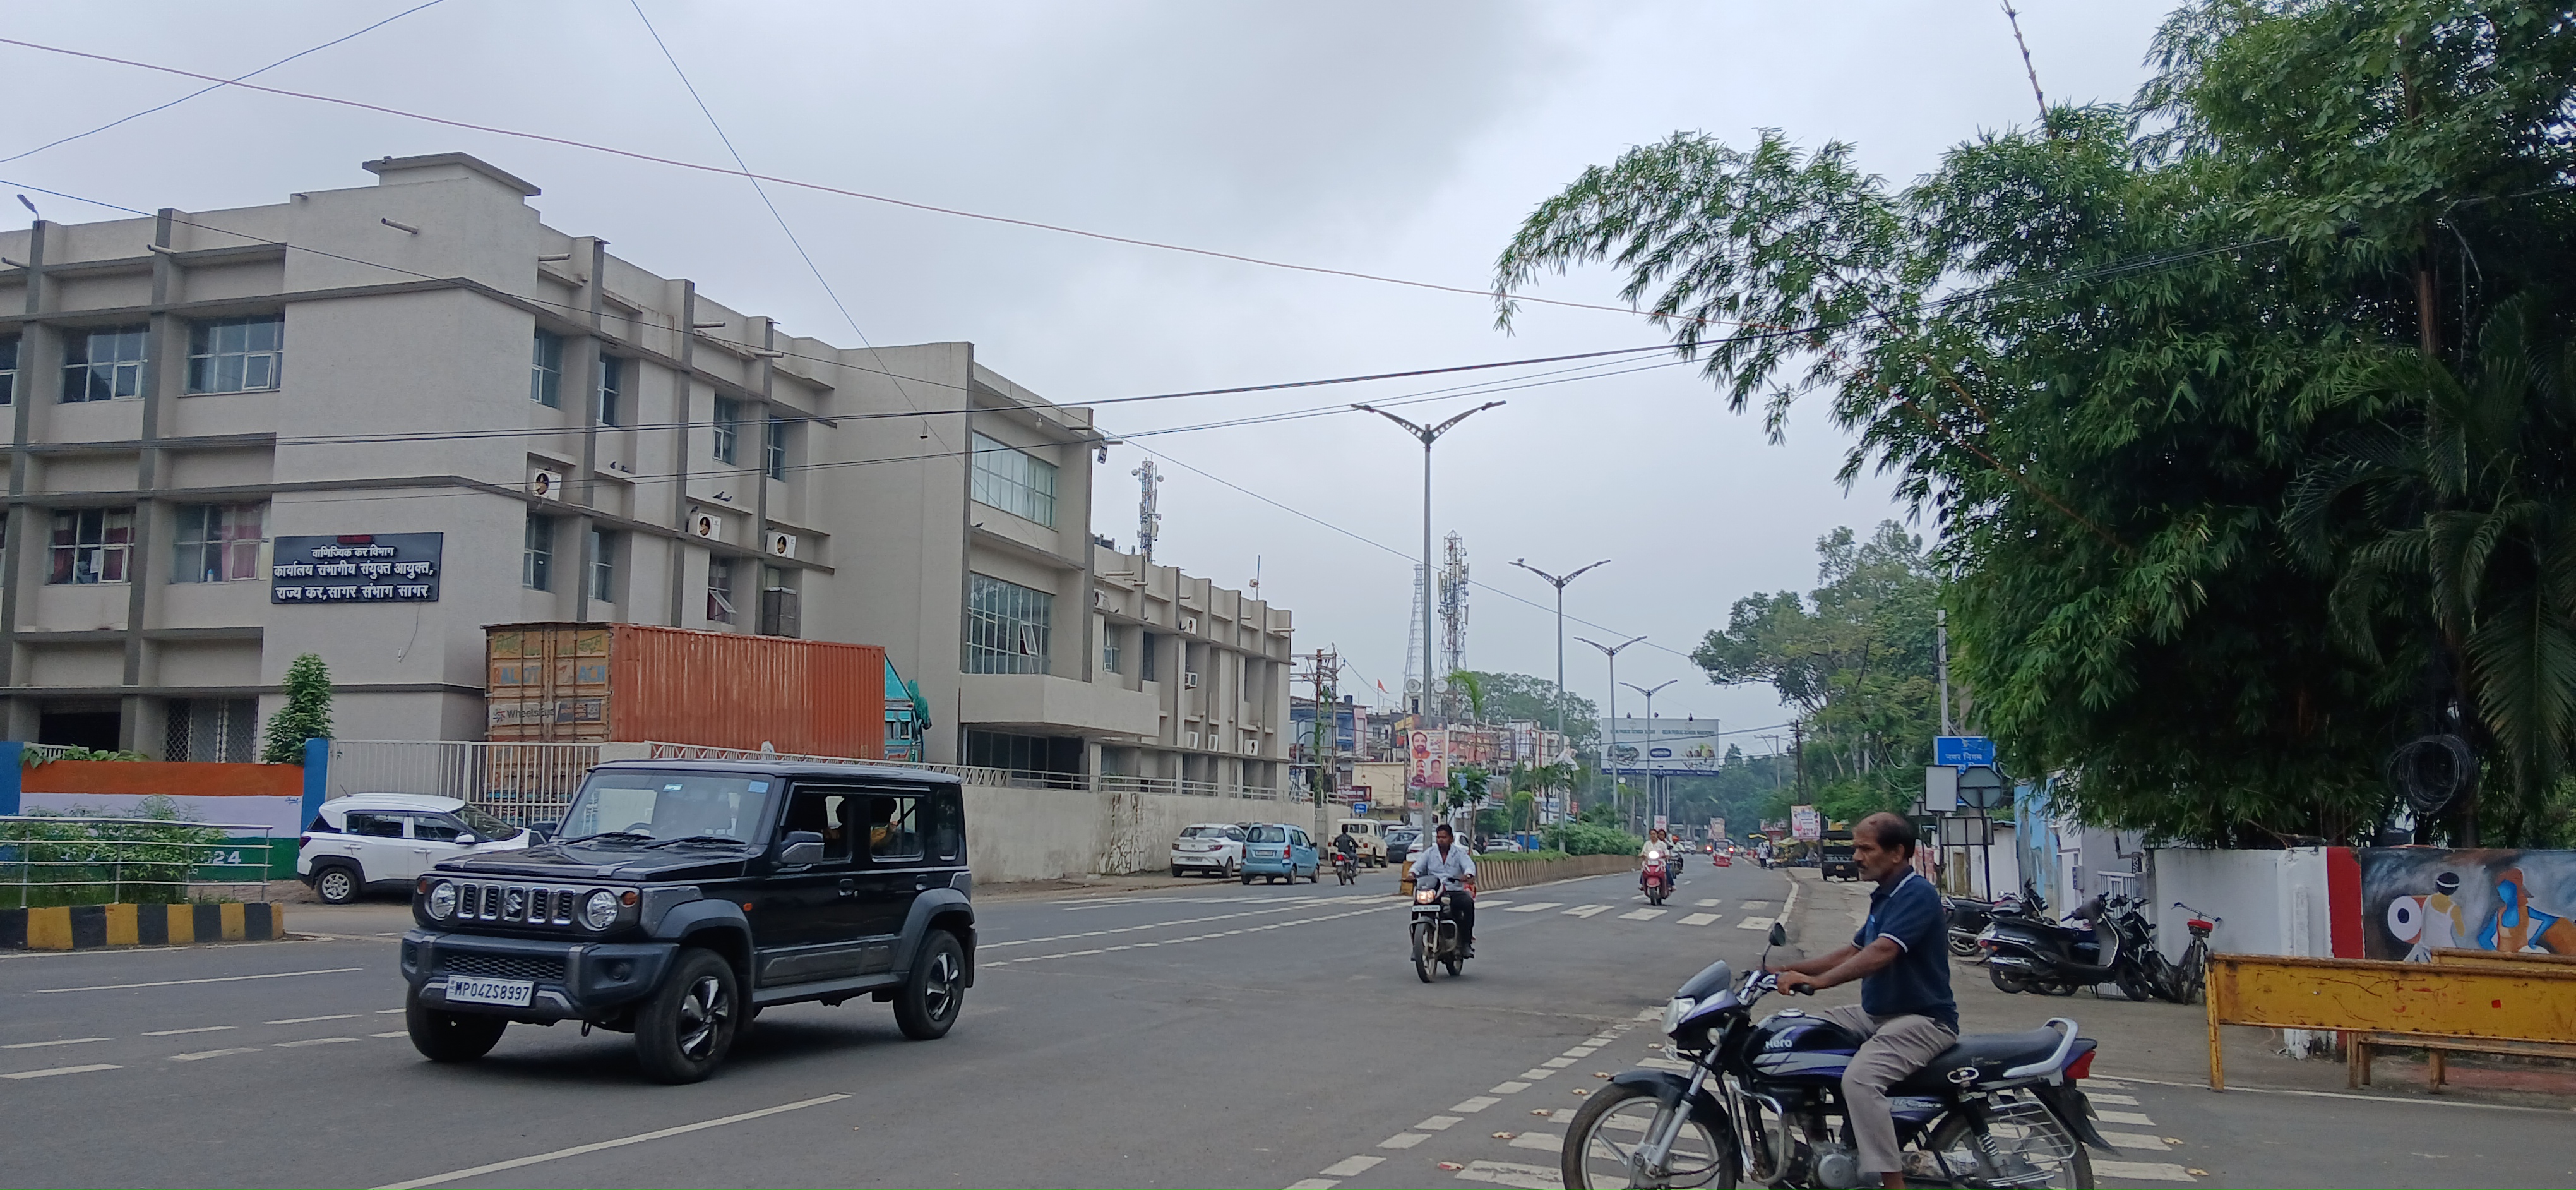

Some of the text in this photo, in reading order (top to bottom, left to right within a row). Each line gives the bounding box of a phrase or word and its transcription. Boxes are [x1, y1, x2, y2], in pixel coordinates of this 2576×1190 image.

[311, 546, 353, 557] वाणिज्यिक
[354, 548, 369, 556] कर
[273, 560, 313, 577] कार्यालय
[360, 560, 391, 579] संयुक्त
[394, 562, 434, 579] आयुक्त,
[275, 587, 302, 599] राज्य
[361, 582, 393, 598] संभाग
[397, 585, 429, 598] सागर
[455, 982, 530, 1001] MP04ZS8997
